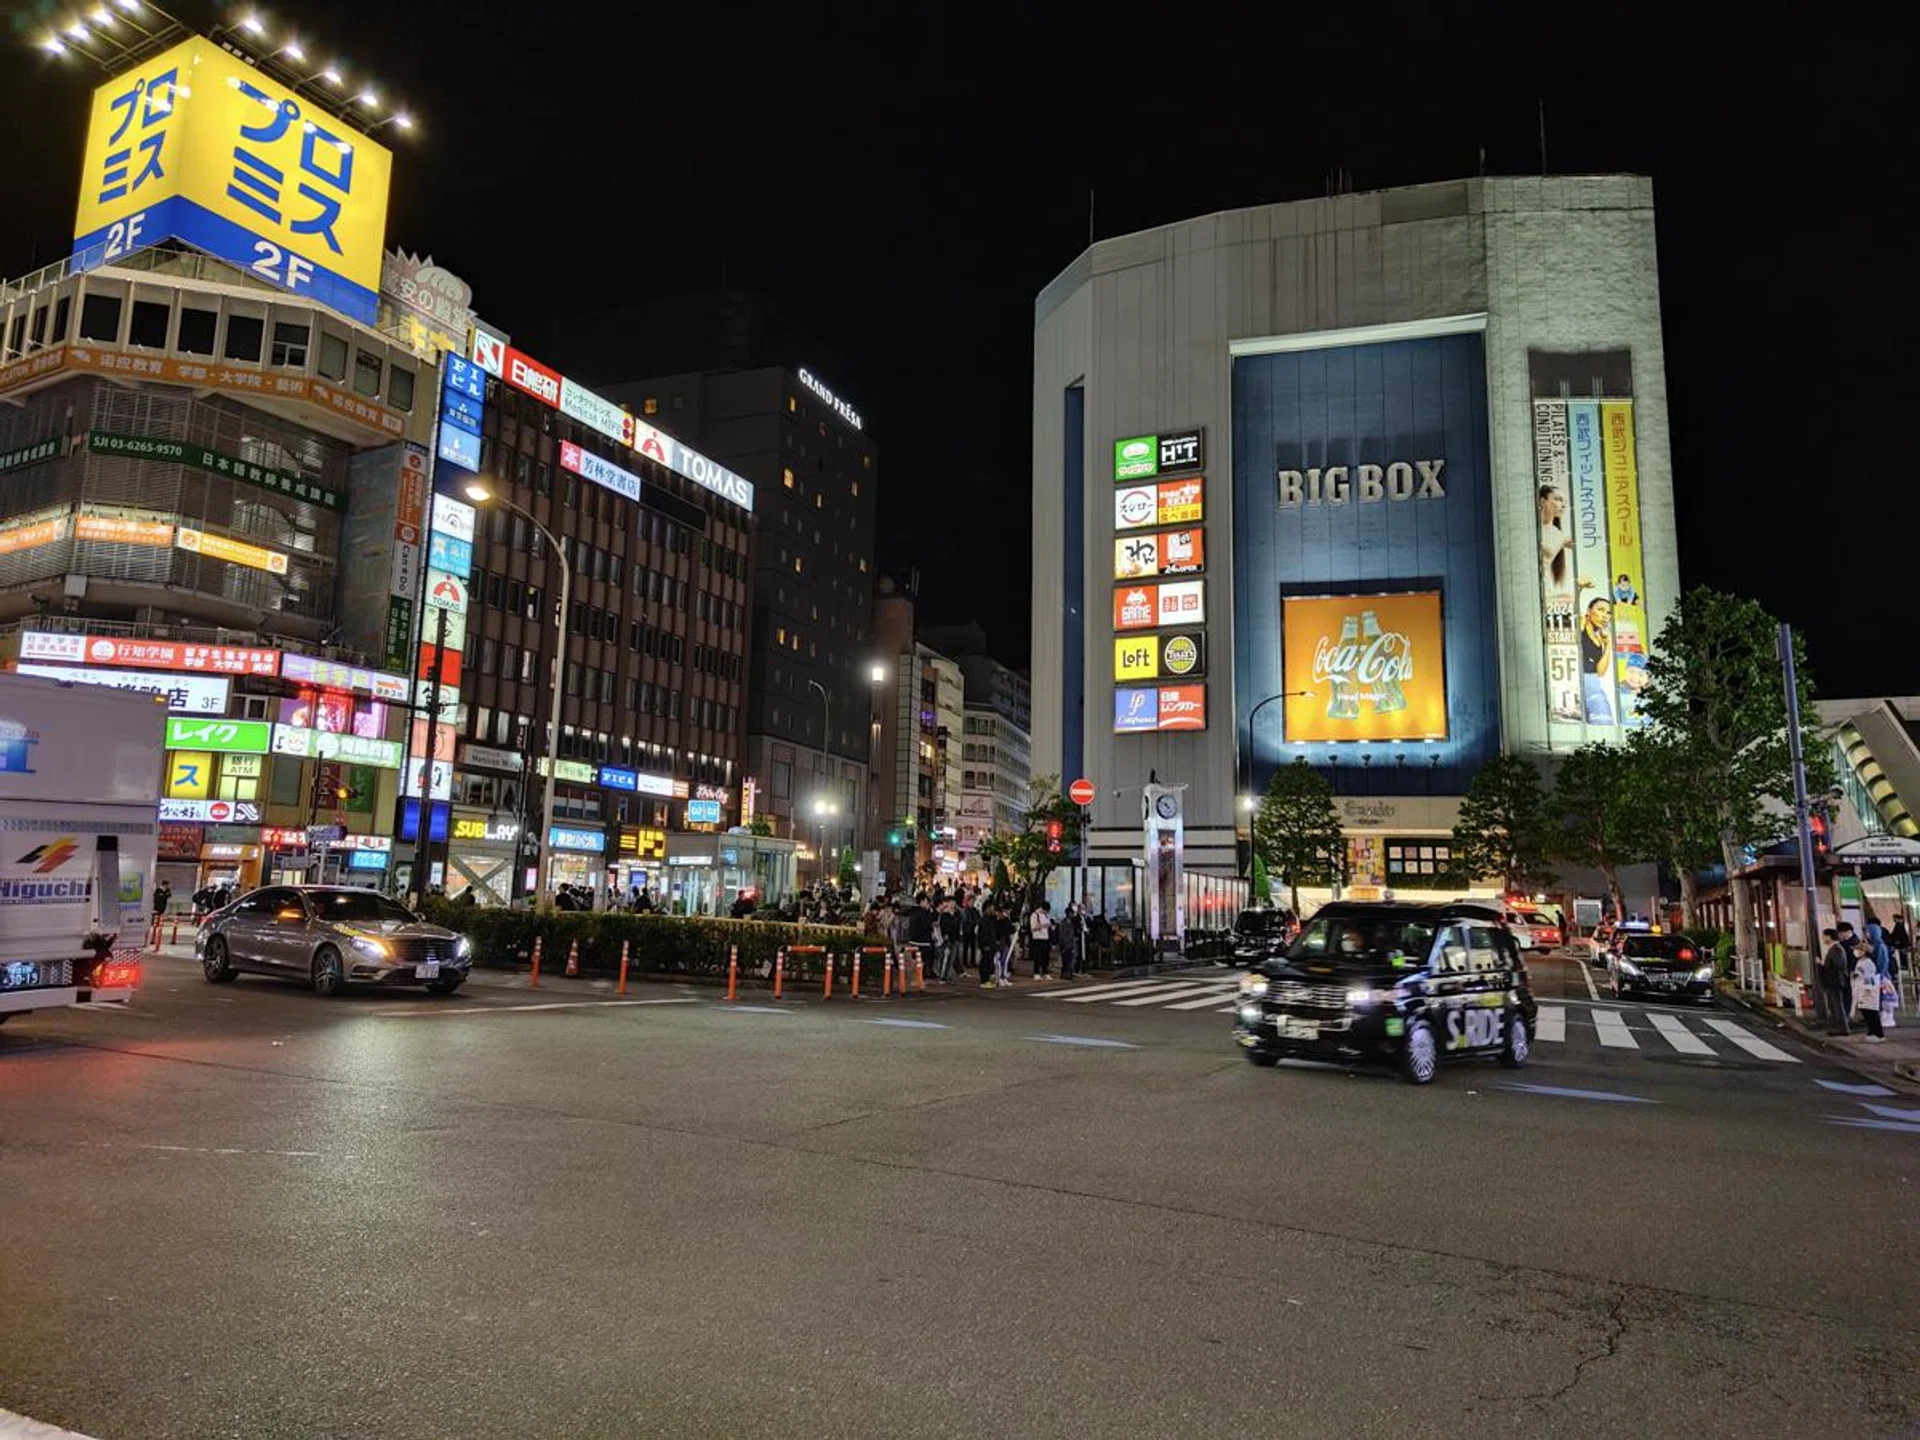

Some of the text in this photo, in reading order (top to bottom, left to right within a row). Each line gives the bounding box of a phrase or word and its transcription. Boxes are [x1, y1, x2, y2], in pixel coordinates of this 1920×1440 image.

[104, 213, 146, 260] 2F
[251, 240, 314, 297] 2F
[800, 368, 833, 405] GRAND
[1552, 403, 1566, 446] PILATES
[110, 440, 183, 457] 03-6265-9570
[1536, 403, 1554, 483] CONDITIONING
[583, 457, 638, 496] 芳林堂書店
[679, 448, 748, 505] TOMAS
[1279, 459, 1446, 508] BIG BOX
[1575, 412, 1602, 549] 西武フィットネスクラブ
[1611, 412, 1633, 548] 西武ジュニアスクール
[433, 596, 460, 610] TOMAS
[1546, 603, 1575, 615] 2024
[118, 643, 174, 660] 行知学園
[1548, 632, 1576, 643] START
[1313, 632, 1413, 685] Coca-Cola
[1551, 657, 1577, 681] 5F
[202, 697, 219, 709] 3F
[173, 721, 238, 743] レイク
[175, 765, 199, 786] ス
[230, 766, 254, 774] ATM
[232, 756, 255, 766] 銀行
